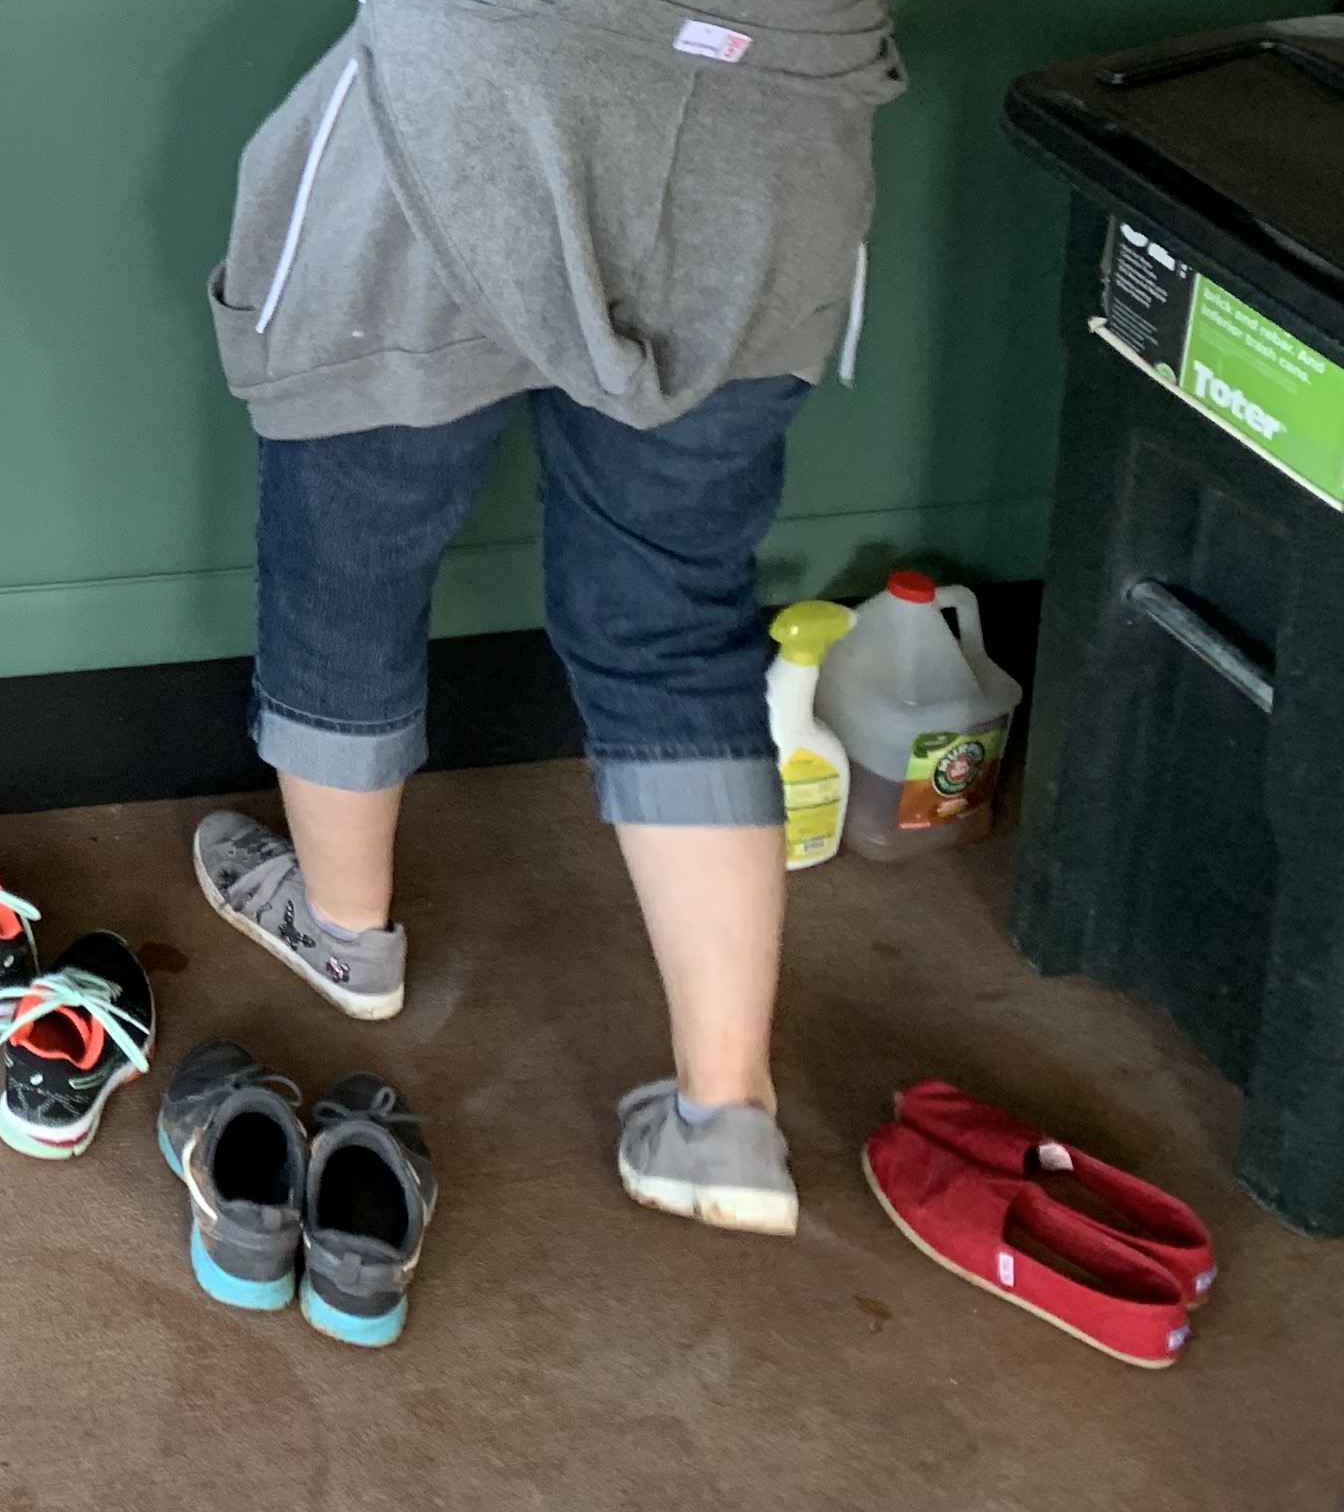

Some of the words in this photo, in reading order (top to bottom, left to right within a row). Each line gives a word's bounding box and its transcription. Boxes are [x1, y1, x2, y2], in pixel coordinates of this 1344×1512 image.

[1233, 309, 1259, 331] and
[1296, 349, 1326, 375] And
[1192, 359, 1288, 442] Toter
